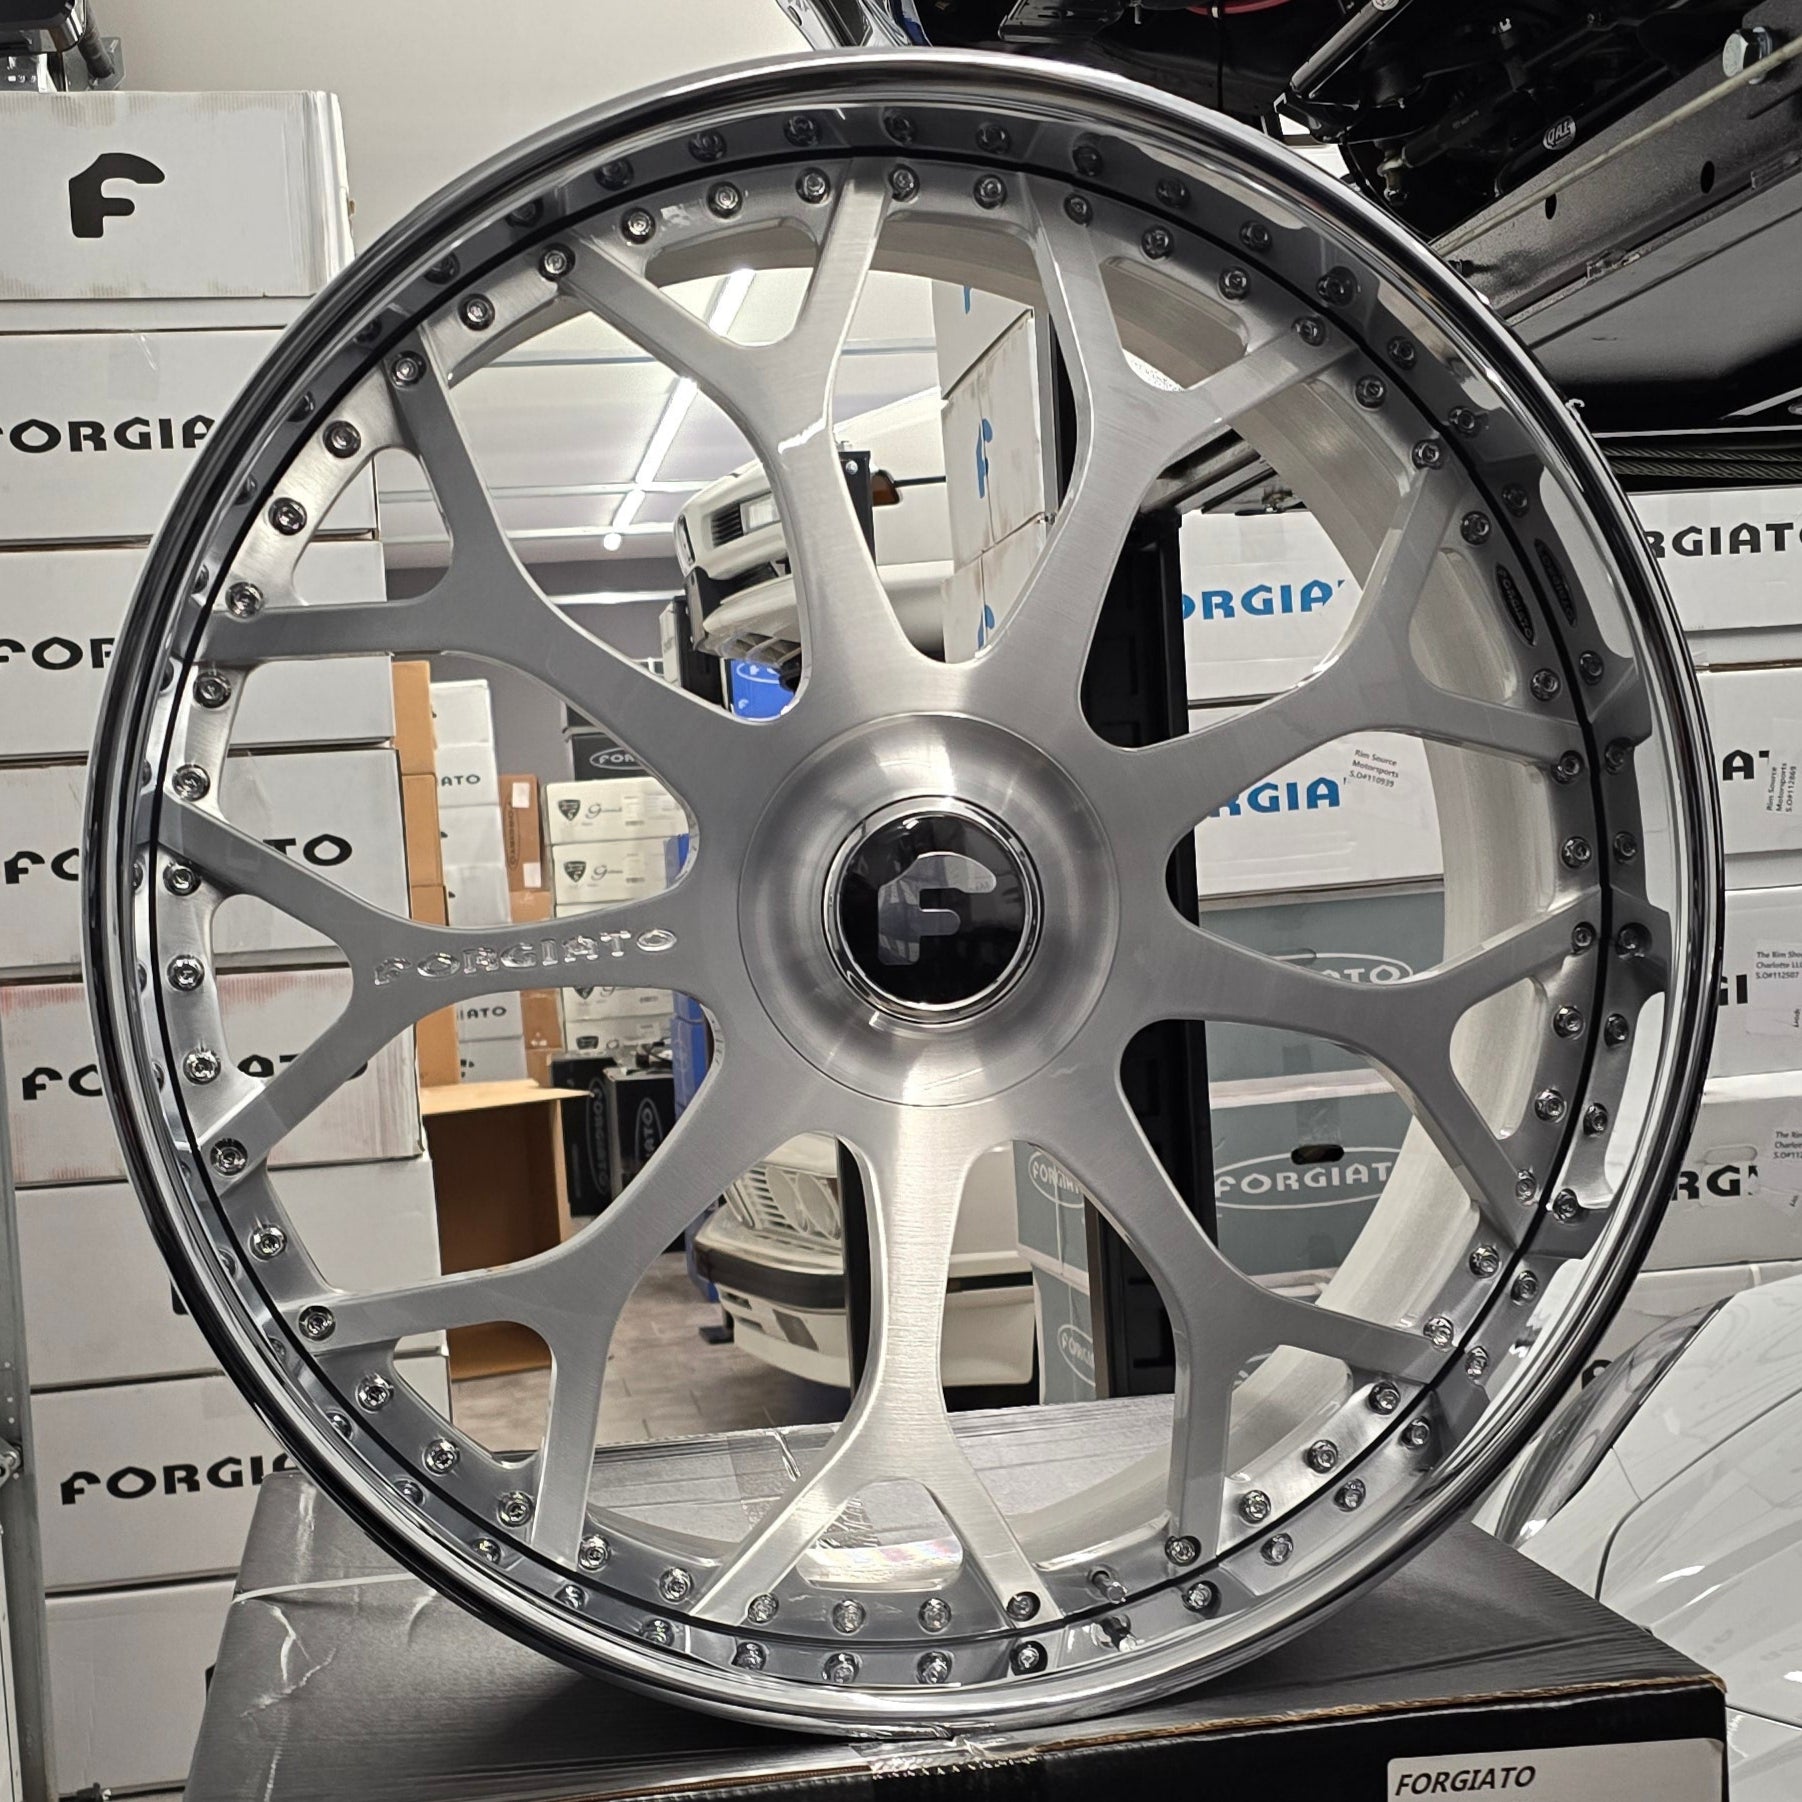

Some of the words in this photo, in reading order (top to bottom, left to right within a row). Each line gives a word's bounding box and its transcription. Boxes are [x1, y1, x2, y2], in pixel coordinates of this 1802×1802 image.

[1642, 522, 1802, 559] RGIAT
[373, 927, 678, 986] FORGIATO
[1395, 1765, 1537, 1797] FORGIATO
